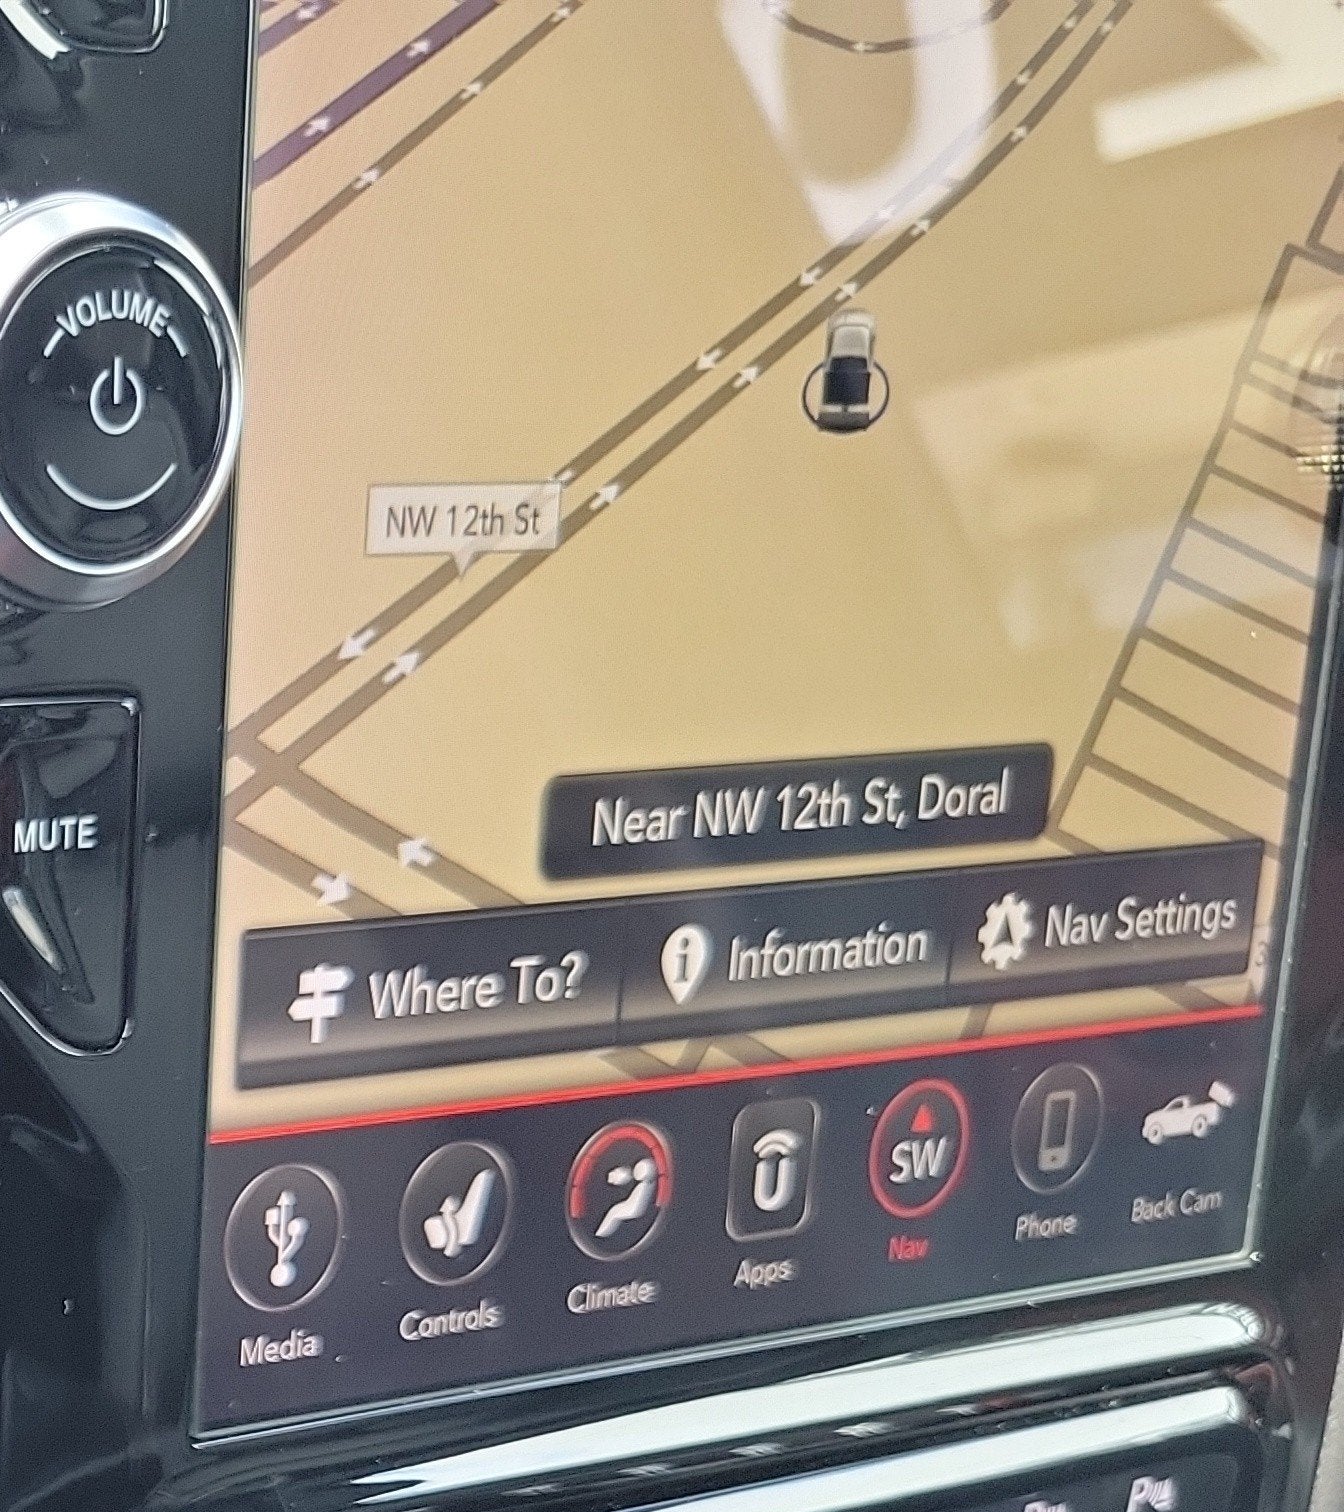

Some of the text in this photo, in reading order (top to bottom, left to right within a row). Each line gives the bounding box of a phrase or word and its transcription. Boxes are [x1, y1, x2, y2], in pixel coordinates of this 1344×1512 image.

[57, 289, 172, 341] VOLUME
[385, 502, 541, 538] NW 12th St
[591, 766, 1011, 848] Near NW 12th St, Doral
[14, 813, 99, 853] MUTE
[1044, 894, 1239, 949] Nav Settings
[727, 923, 929, 982] Information
[369, 950, 589, 1020] Where To?
[890, 1137, 949, 1184] SW
[1130, 1188, 1222, 1224] Back Cam
[1014, 1211, 1079, 1242] Phone
[888, 1236, 930, 1262] Nav
[734, 1256, 796, 1290] Apps
[566, 1282, 656, 1314] Climate
[399, 1299, 502, 1341] Controls
[239, 1332, 320, 1366] Media
